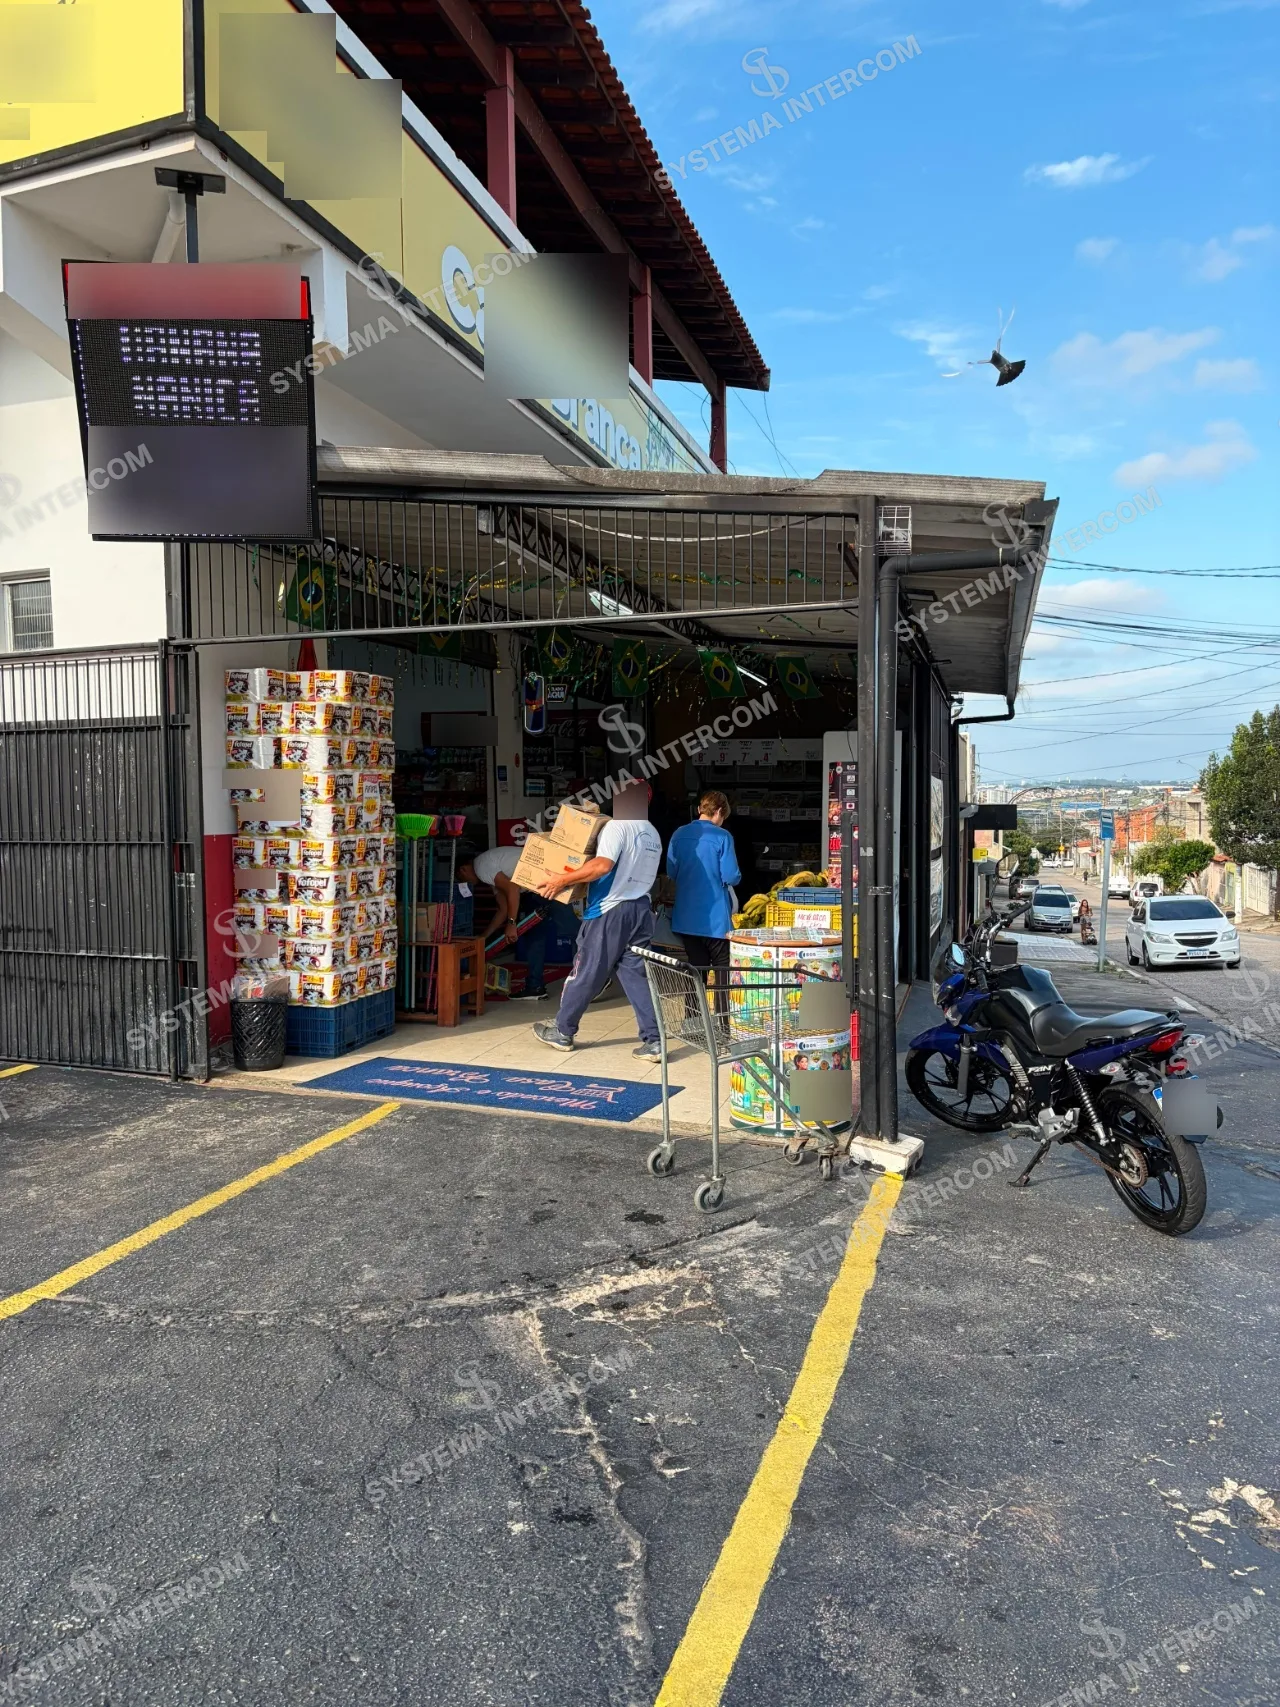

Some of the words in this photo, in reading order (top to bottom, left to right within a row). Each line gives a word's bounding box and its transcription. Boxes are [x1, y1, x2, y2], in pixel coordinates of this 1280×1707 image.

[298, 877, 327, 888] fofopel
[296, 945, 324, 955] fofopel
[386, 1065, 490, 1084] Branca
[501, 1075, 573, 1093] Casa
[496, 1090, 597, 1110] Mercado
